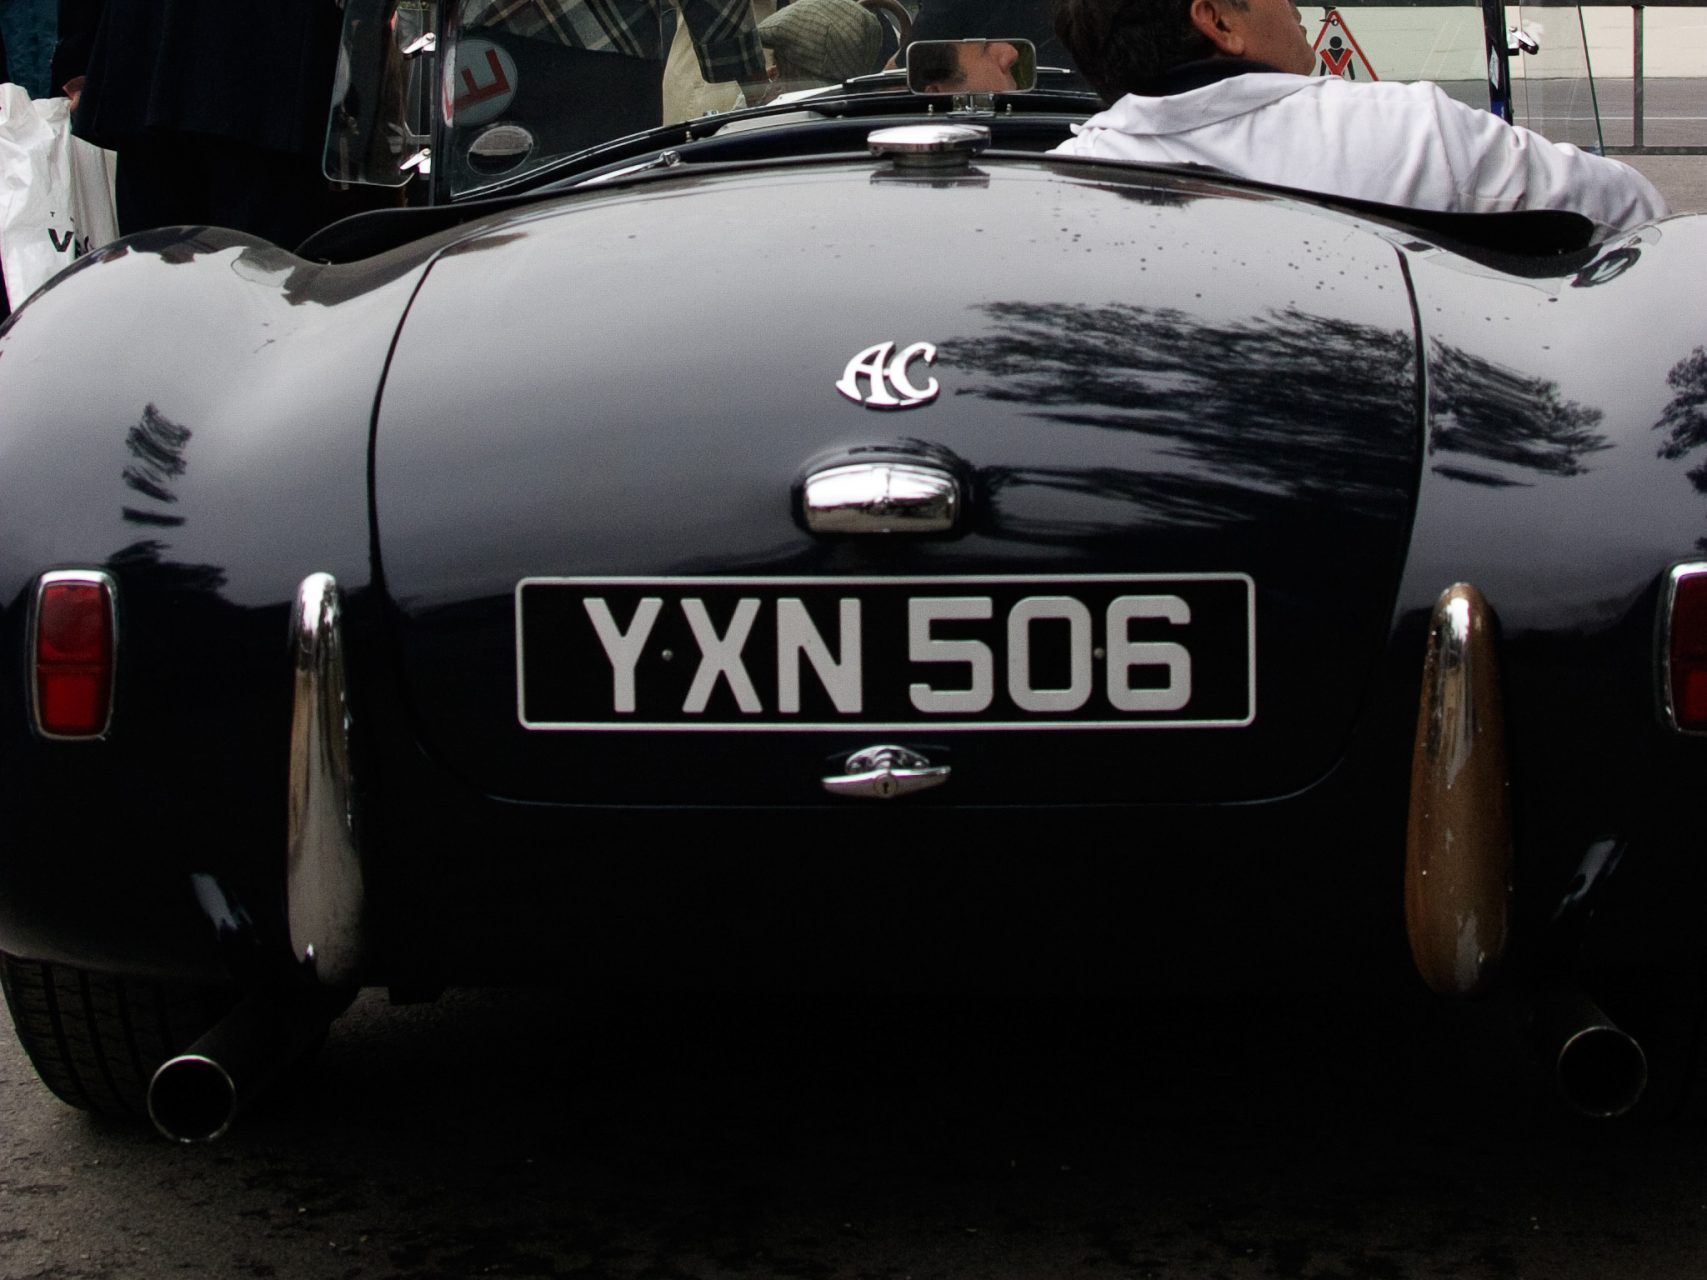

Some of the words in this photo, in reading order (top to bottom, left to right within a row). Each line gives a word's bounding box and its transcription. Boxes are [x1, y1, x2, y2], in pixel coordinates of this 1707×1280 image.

[835, 340, 941, 413] AC
[583, 597, 863, 714] YXN
[908, 595, 1192, 713] 506
